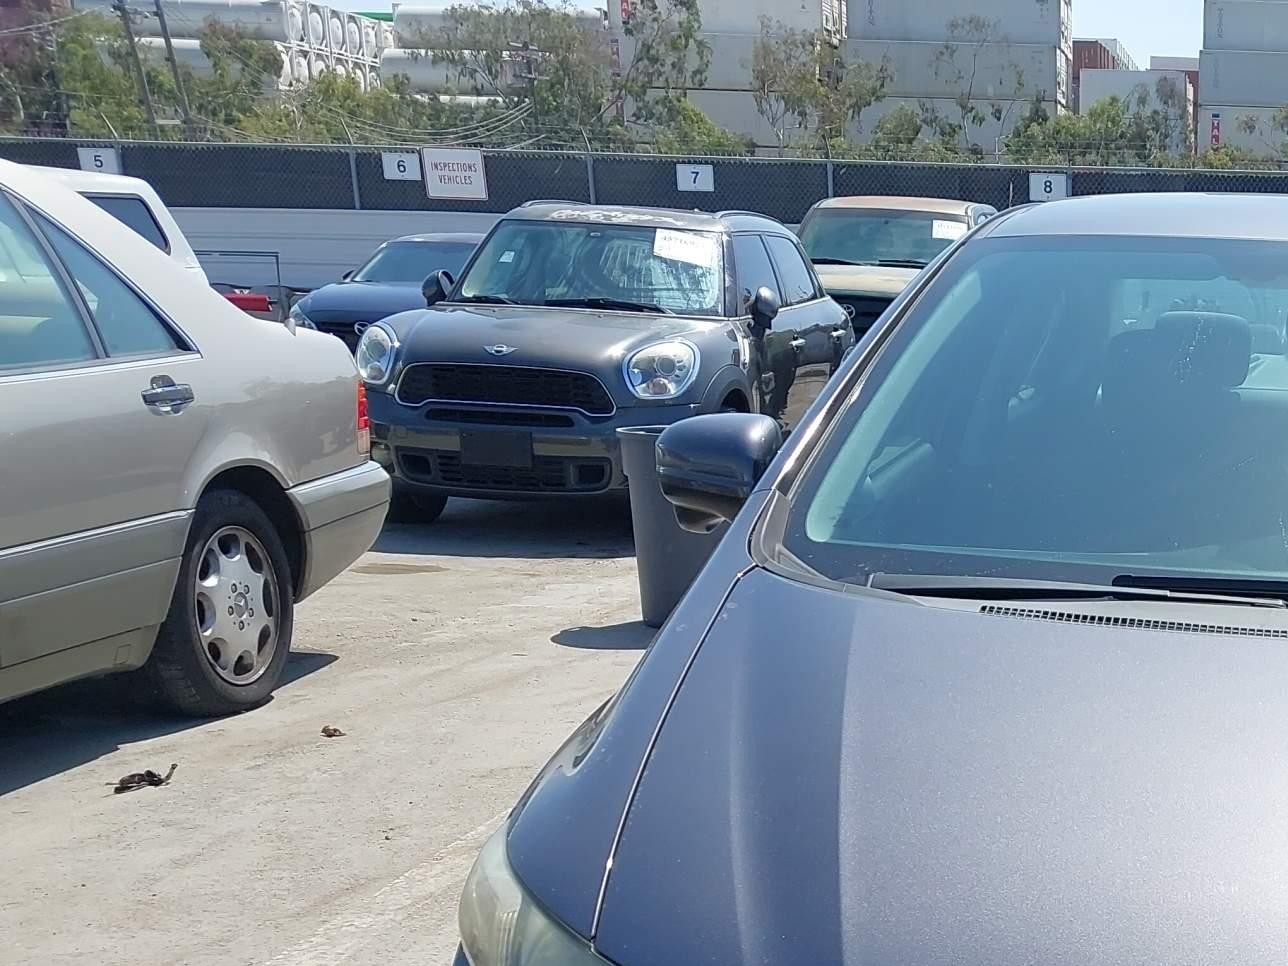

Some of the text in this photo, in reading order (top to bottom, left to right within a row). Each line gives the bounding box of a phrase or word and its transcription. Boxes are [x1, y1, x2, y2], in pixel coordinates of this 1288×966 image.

[93, 154, 104, 168] 5
[396, 159, 407, 173] 6
[430, 161, 478, 173] INSPECTIONS
[438, 174, 473, 185] VEHICLES
[690, 171, 700, 185] 7
[1043, 180, 1053, 194] 8
